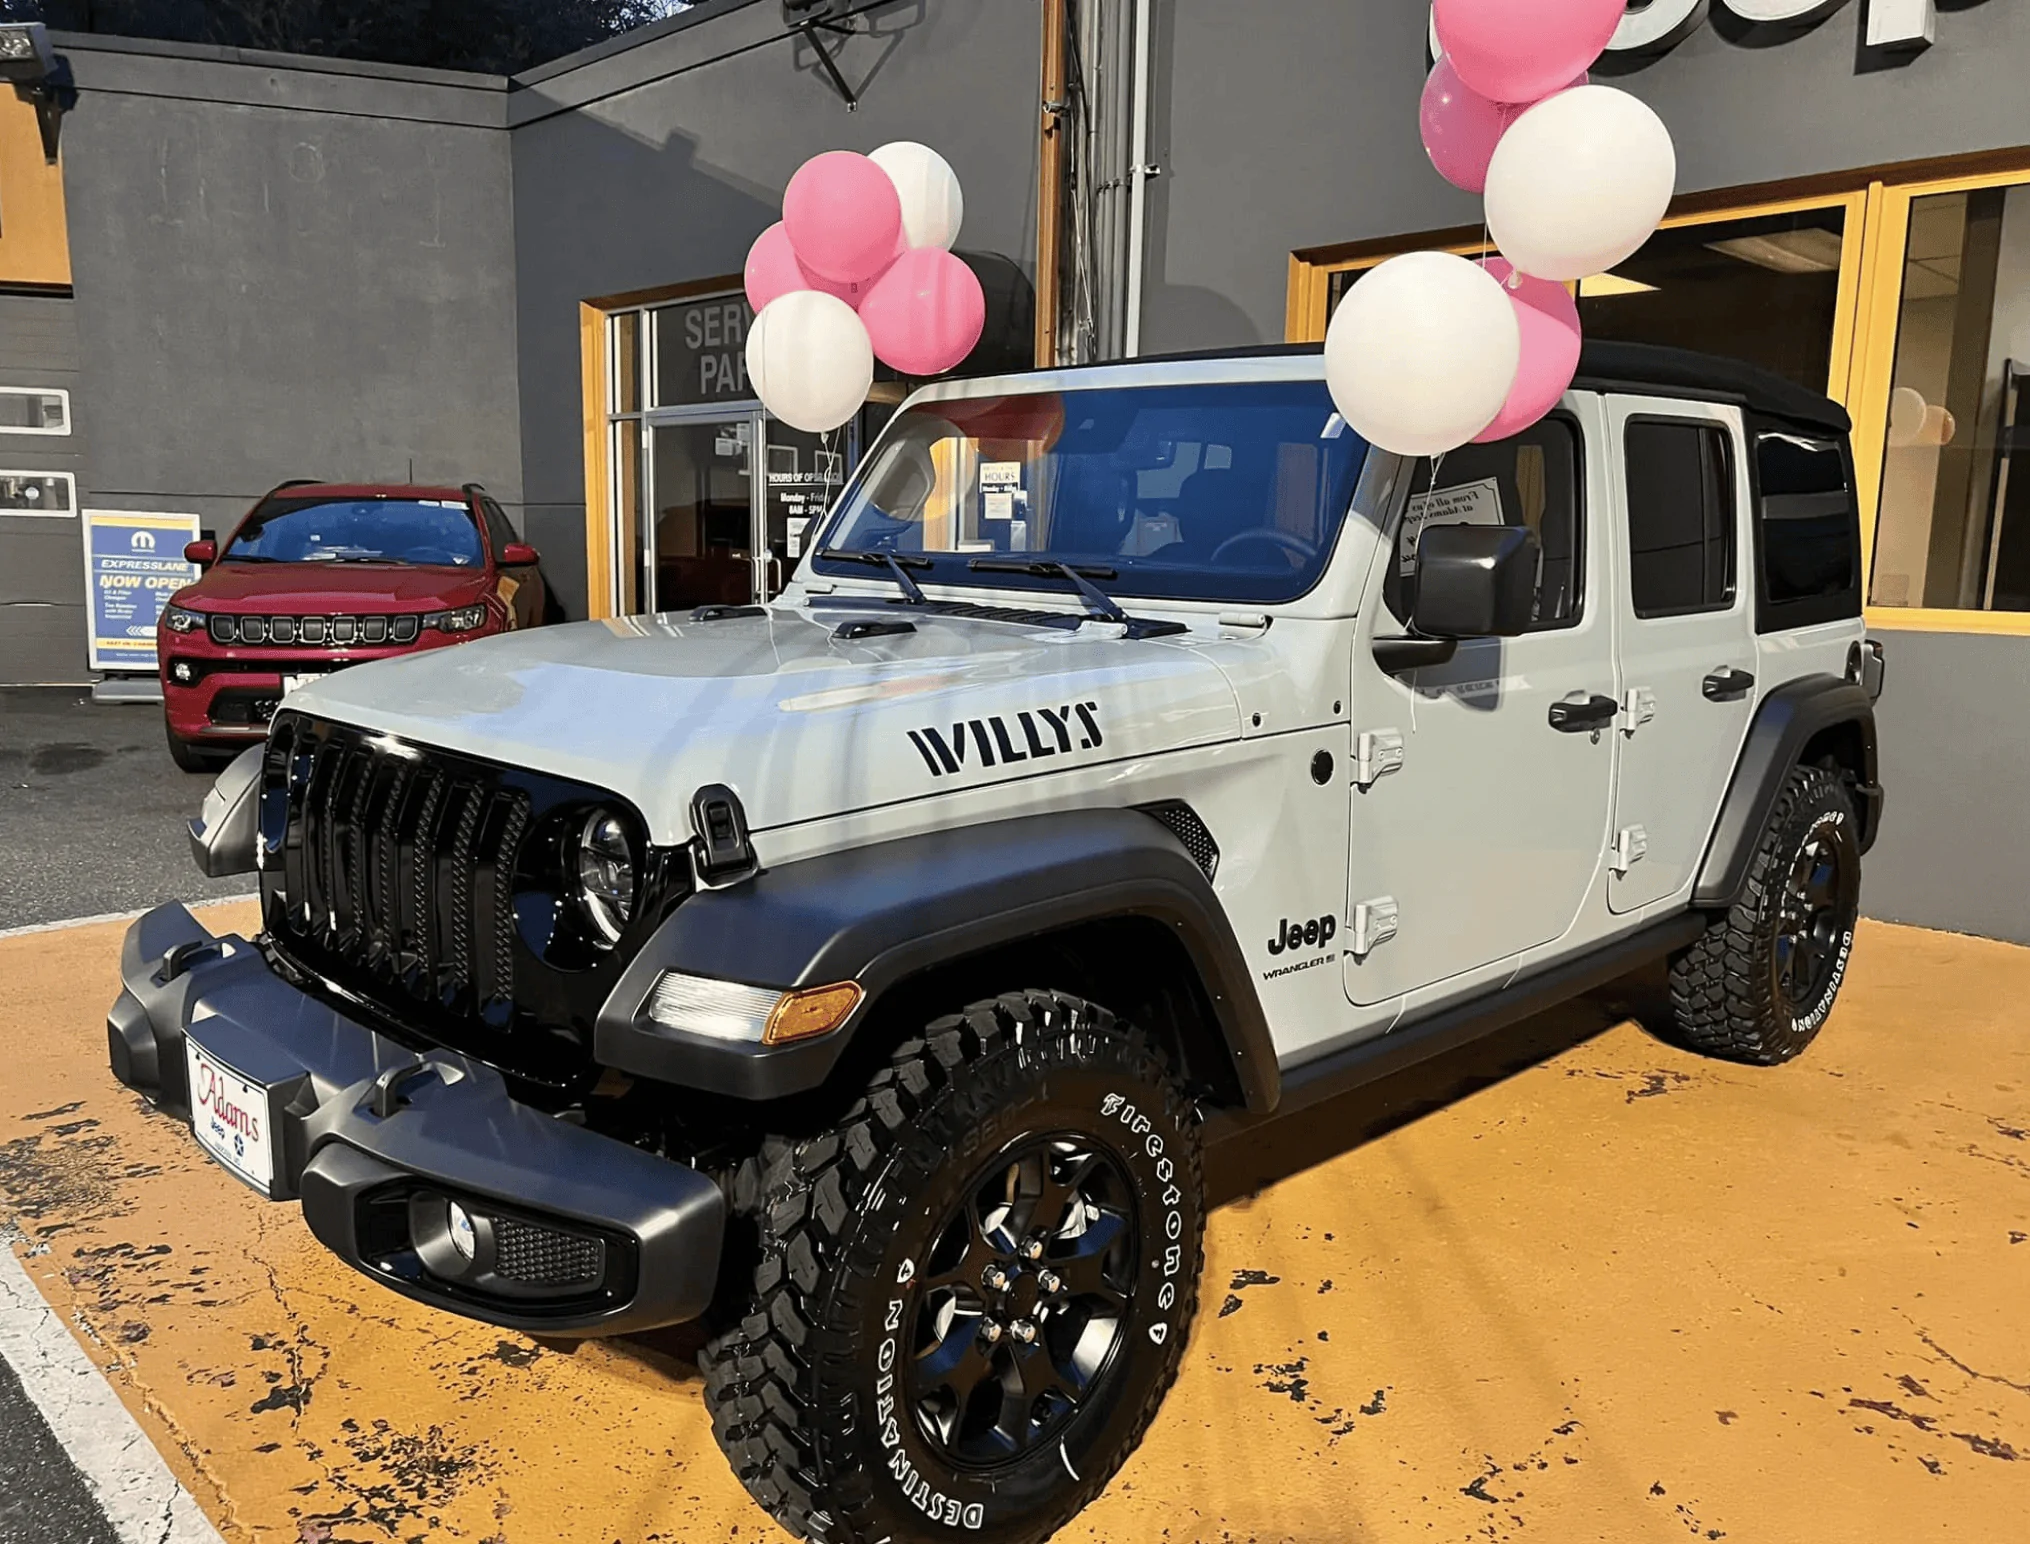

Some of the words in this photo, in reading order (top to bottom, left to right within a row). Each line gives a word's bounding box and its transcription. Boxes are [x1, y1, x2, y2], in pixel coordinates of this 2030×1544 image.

[769, 472, 793, 483] HOURS
[793, 472, 804, 482] OF
[985, 472, 1015, 481] HOURS
[780, 492, 806, 504] Monday
[810, 492, 831, 505] Fridy
[101, 559, 189, 572] EXPRESSLANE
[99, 575, 142, 588] NOW
[144, 577, 193, 590] OPEN
[906, 701, 1103, 777] WILLYS
[1267, 914, 1337, 956] Jeep
[1263, 957, 1325, 980] WRANGLER
[197, 1062, 259, 1143] Adams
[1100, 1092, 1183, 1311] Firestone
[876, 1299, 985, 1531] DESTINATION
